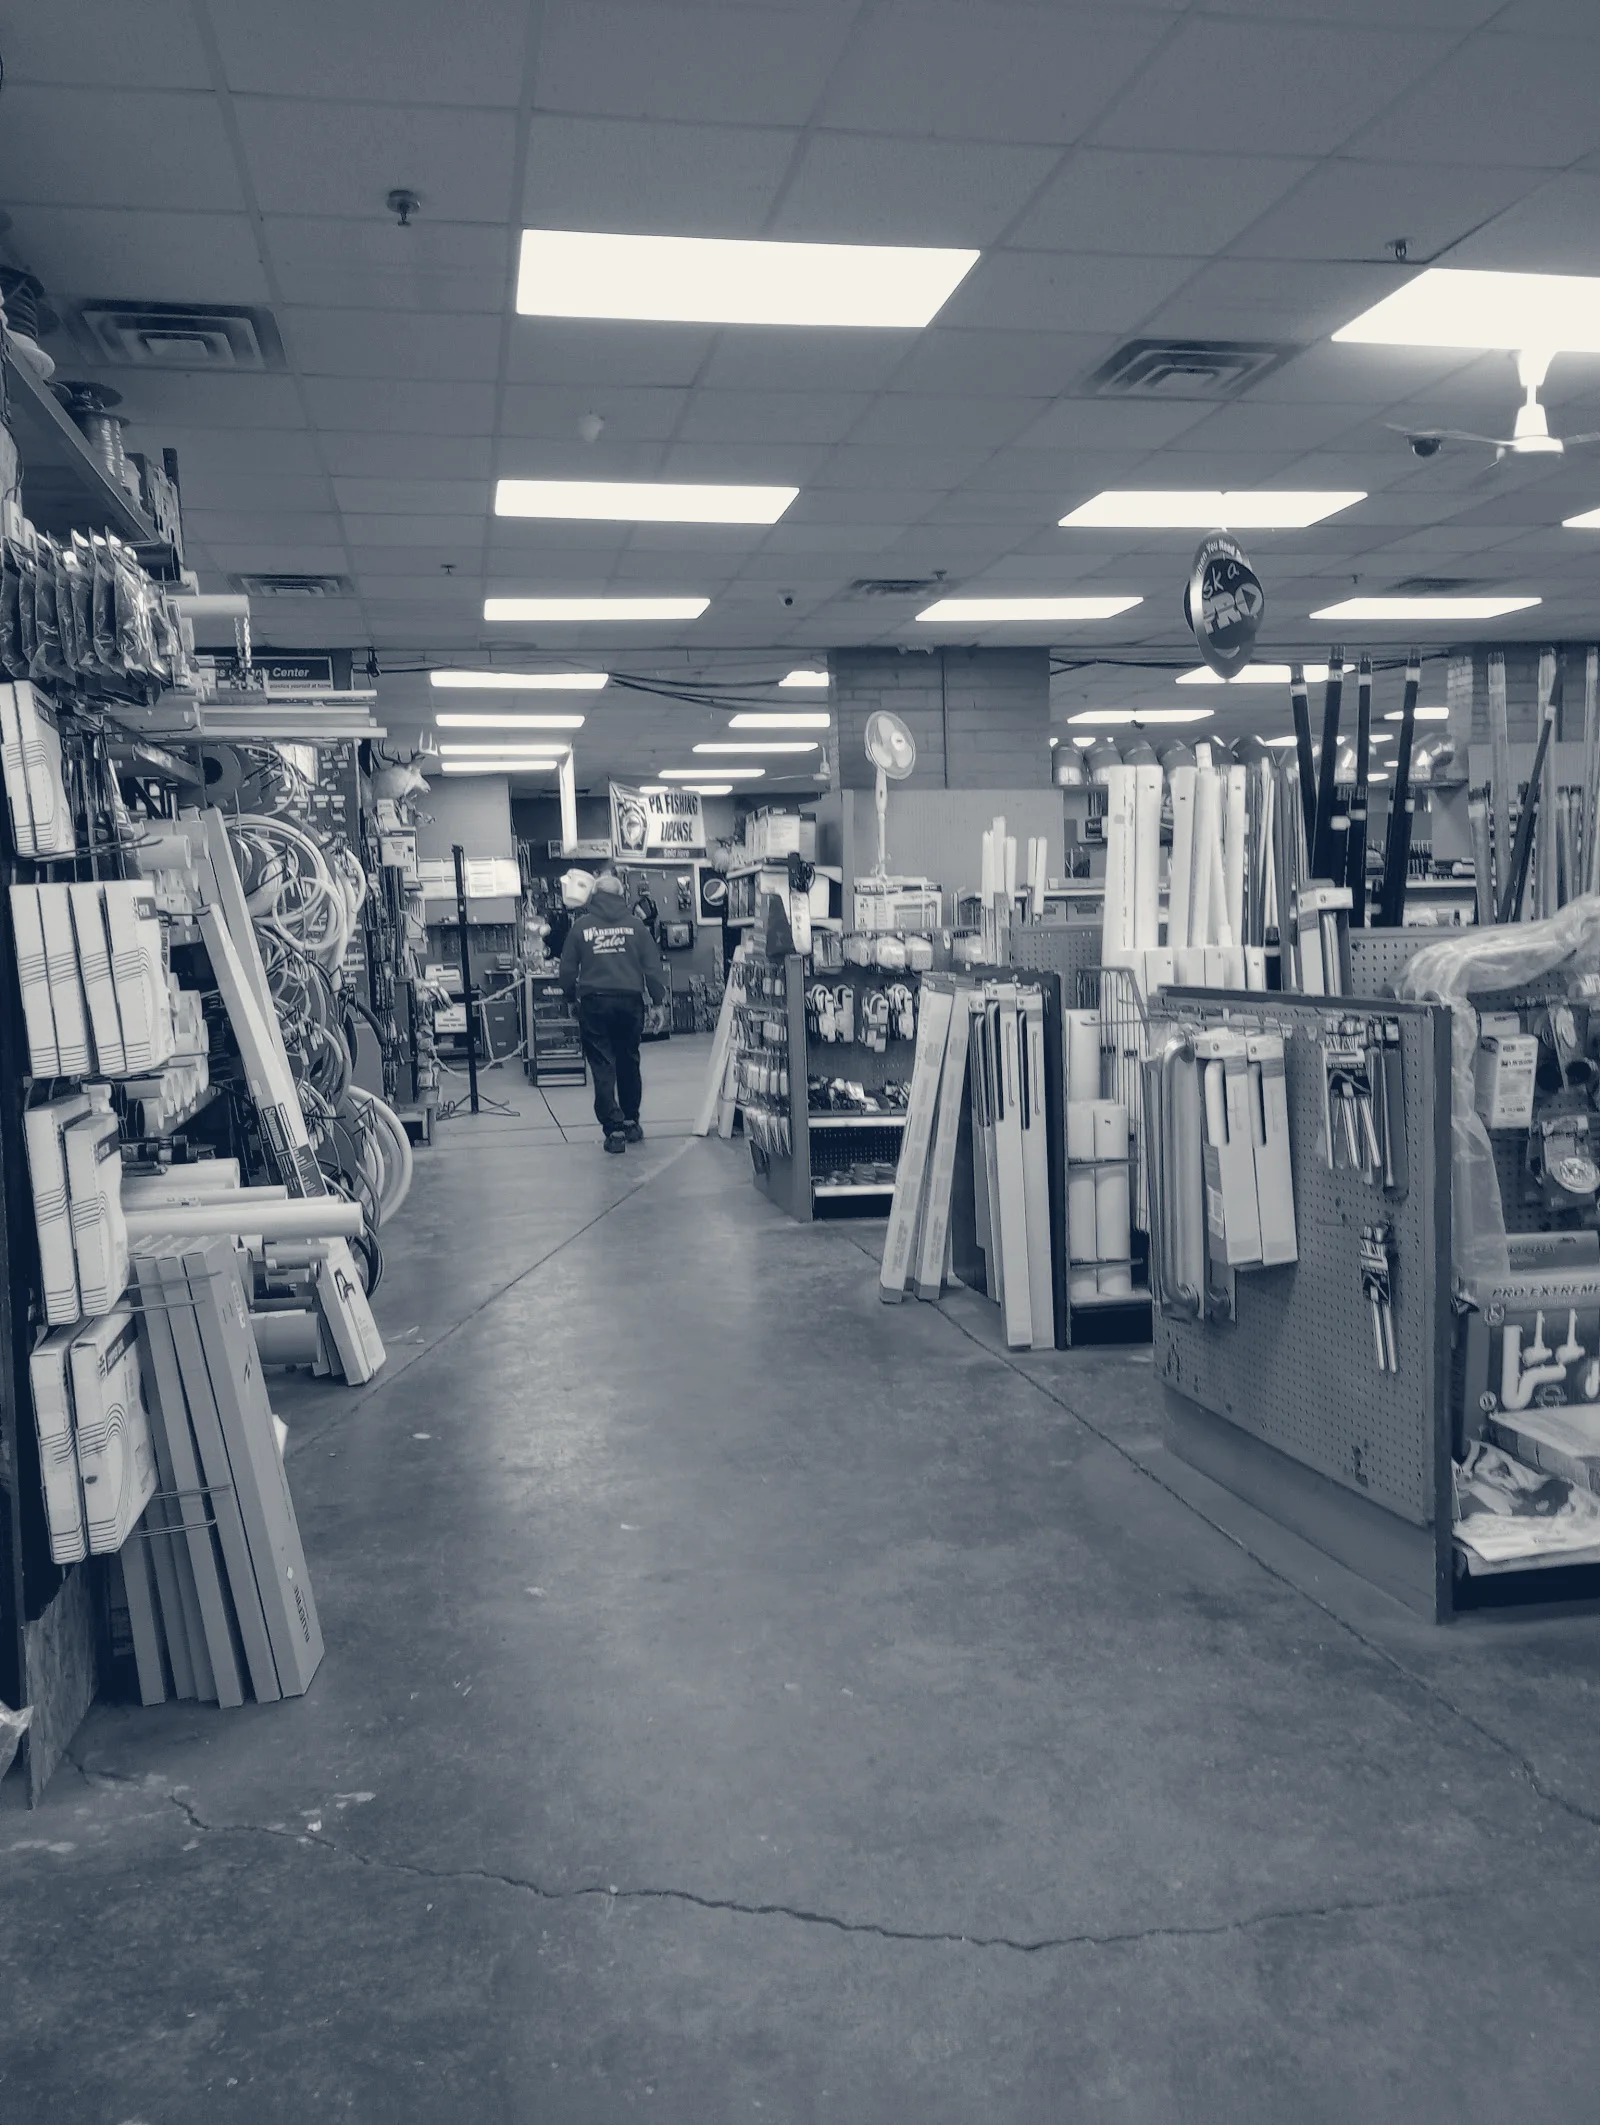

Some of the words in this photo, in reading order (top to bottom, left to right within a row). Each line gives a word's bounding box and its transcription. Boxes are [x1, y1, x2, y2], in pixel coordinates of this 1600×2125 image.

[1203, 566, 1224, 599] sk
[1227, 562, 1240, 580] a
[272, 667, 310, 678] Center
[648, 795, 664, 814] PA
[664, 793, 698, 815] FISHING
[660, 821, 693, 842] LICENSE
[592, 934, 626, 950] Sales
[1492, 1287, 1525, 1298] PRO
